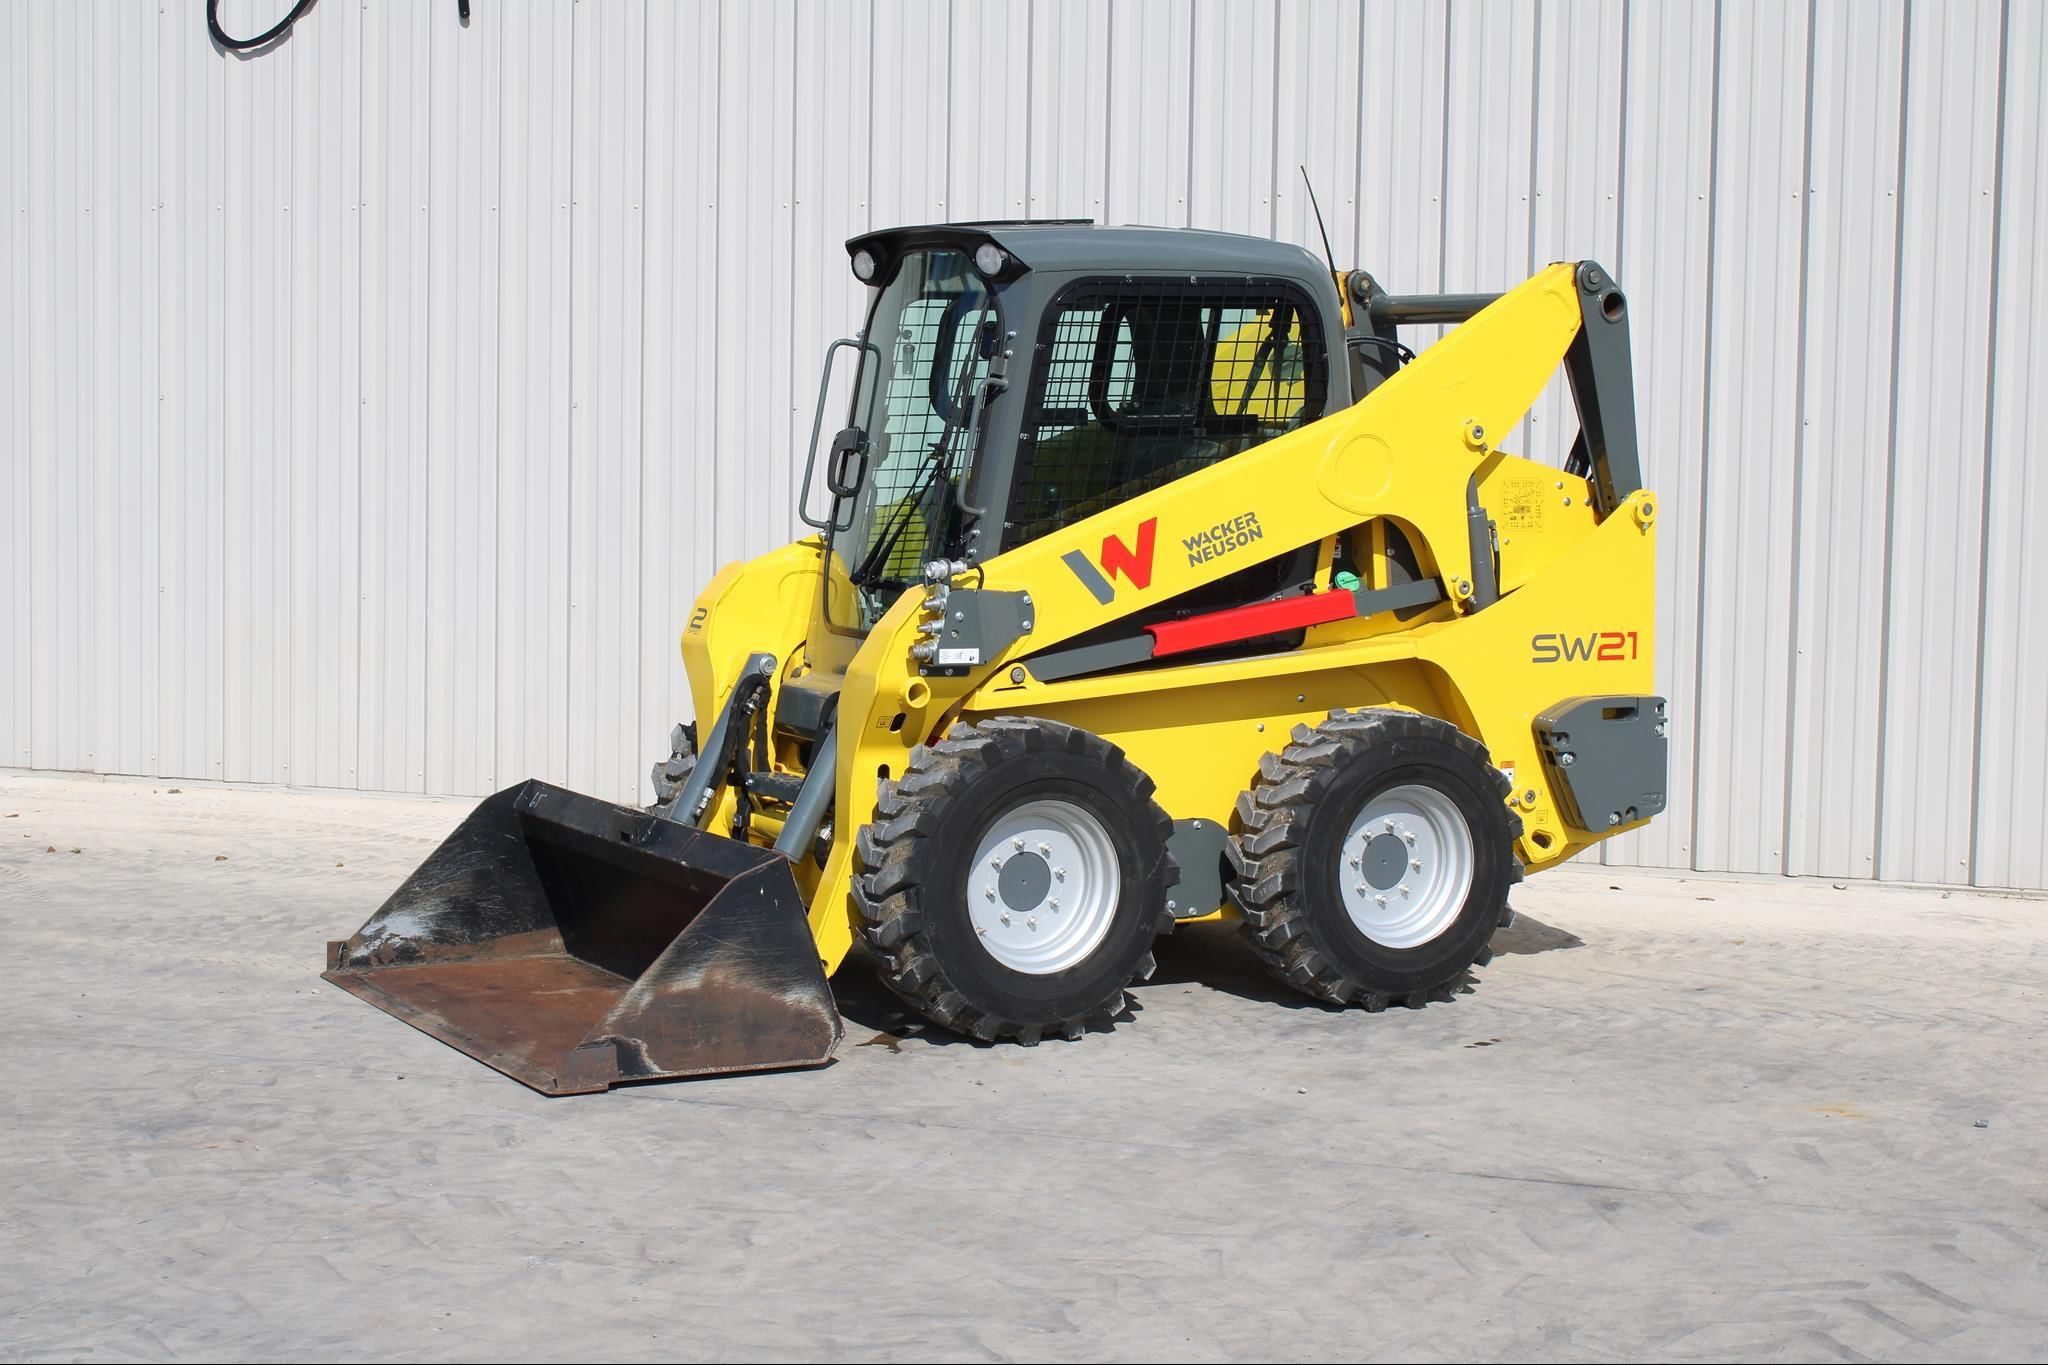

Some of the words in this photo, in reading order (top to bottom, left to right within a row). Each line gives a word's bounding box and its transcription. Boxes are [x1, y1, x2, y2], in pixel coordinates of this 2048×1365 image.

[1182, 512, 1259, 552] WACKER
[1188, 525, 1263, 568] NEUSON
[690, 607, 708, 629] 2
[1531, 632, 1638, 664] SW21
